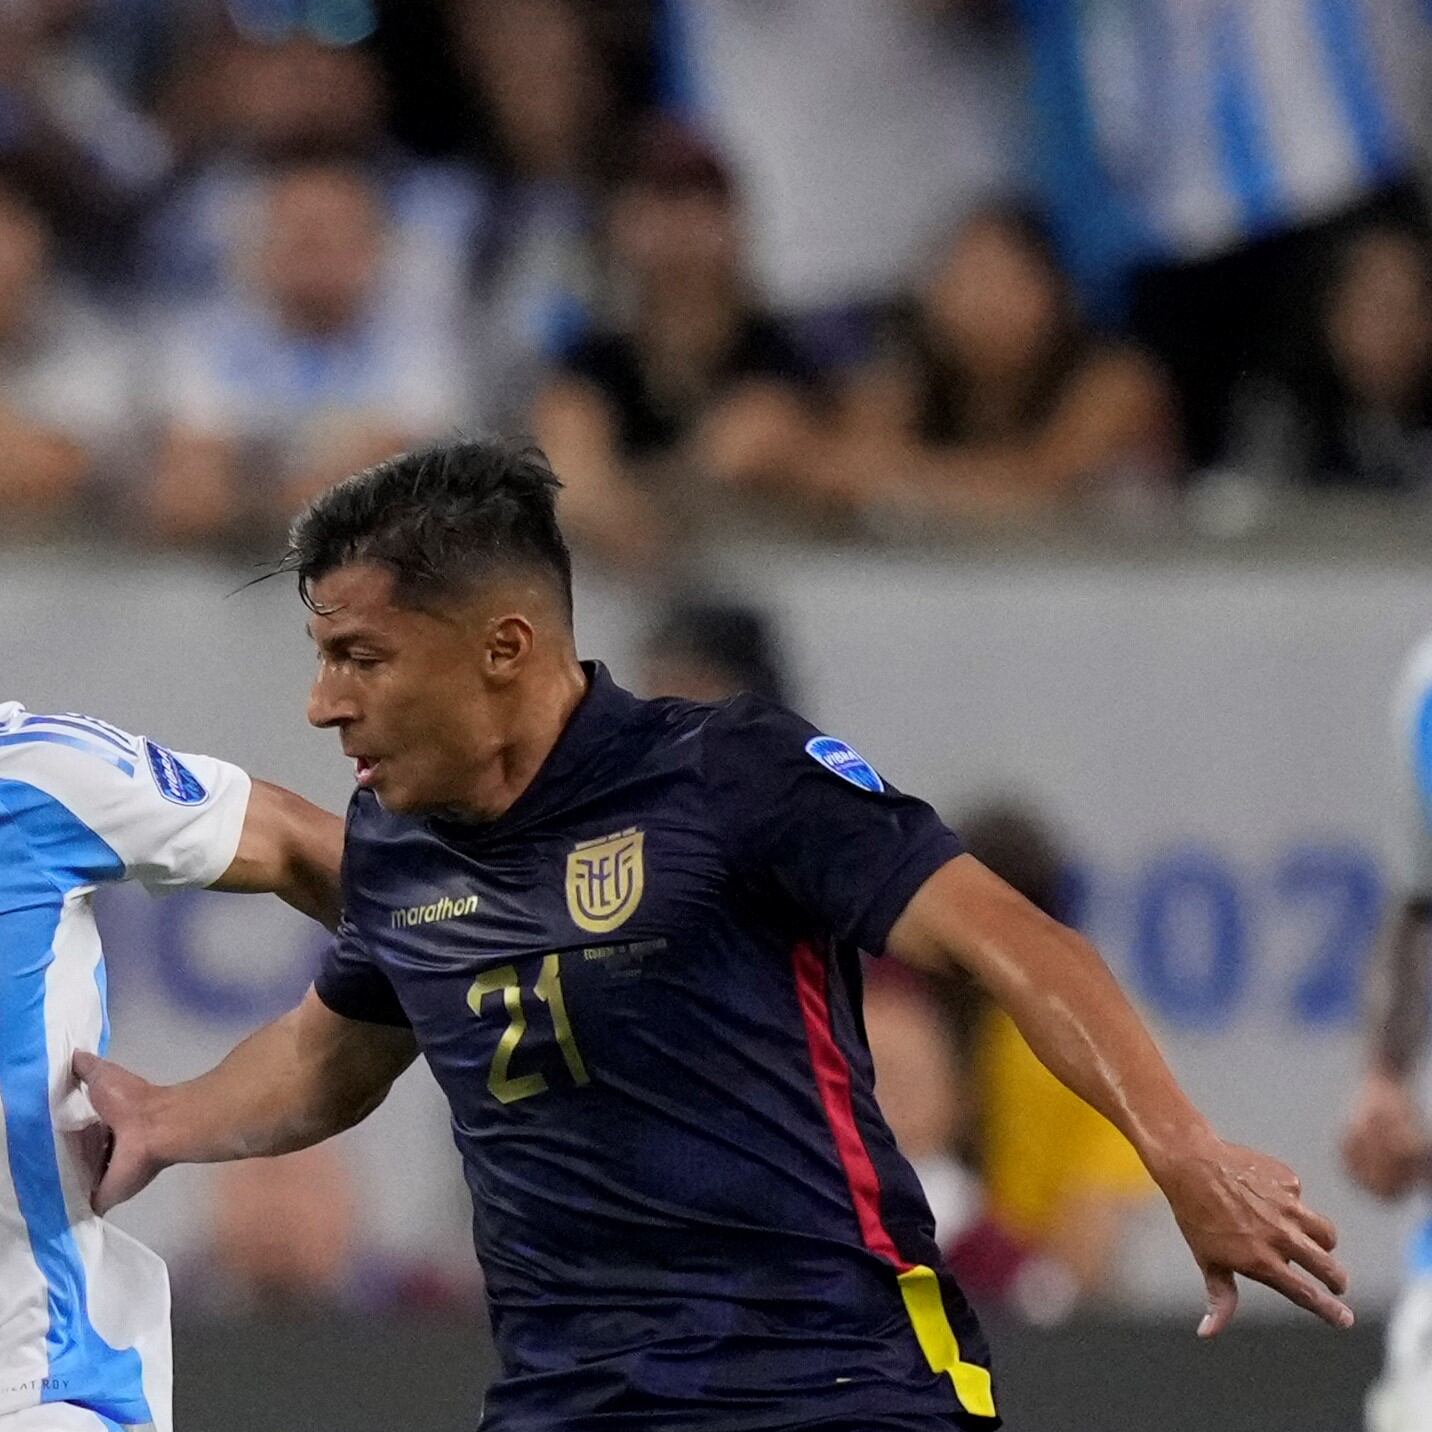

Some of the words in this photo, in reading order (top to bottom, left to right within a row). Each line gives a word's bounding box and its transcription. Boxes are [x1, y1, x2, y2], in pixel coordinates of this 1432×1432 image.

[391, 895, 479, 929] marathon
[466, 953, 592, 1105] 21
[1, 1378, 71, 1393] AT.RDY
